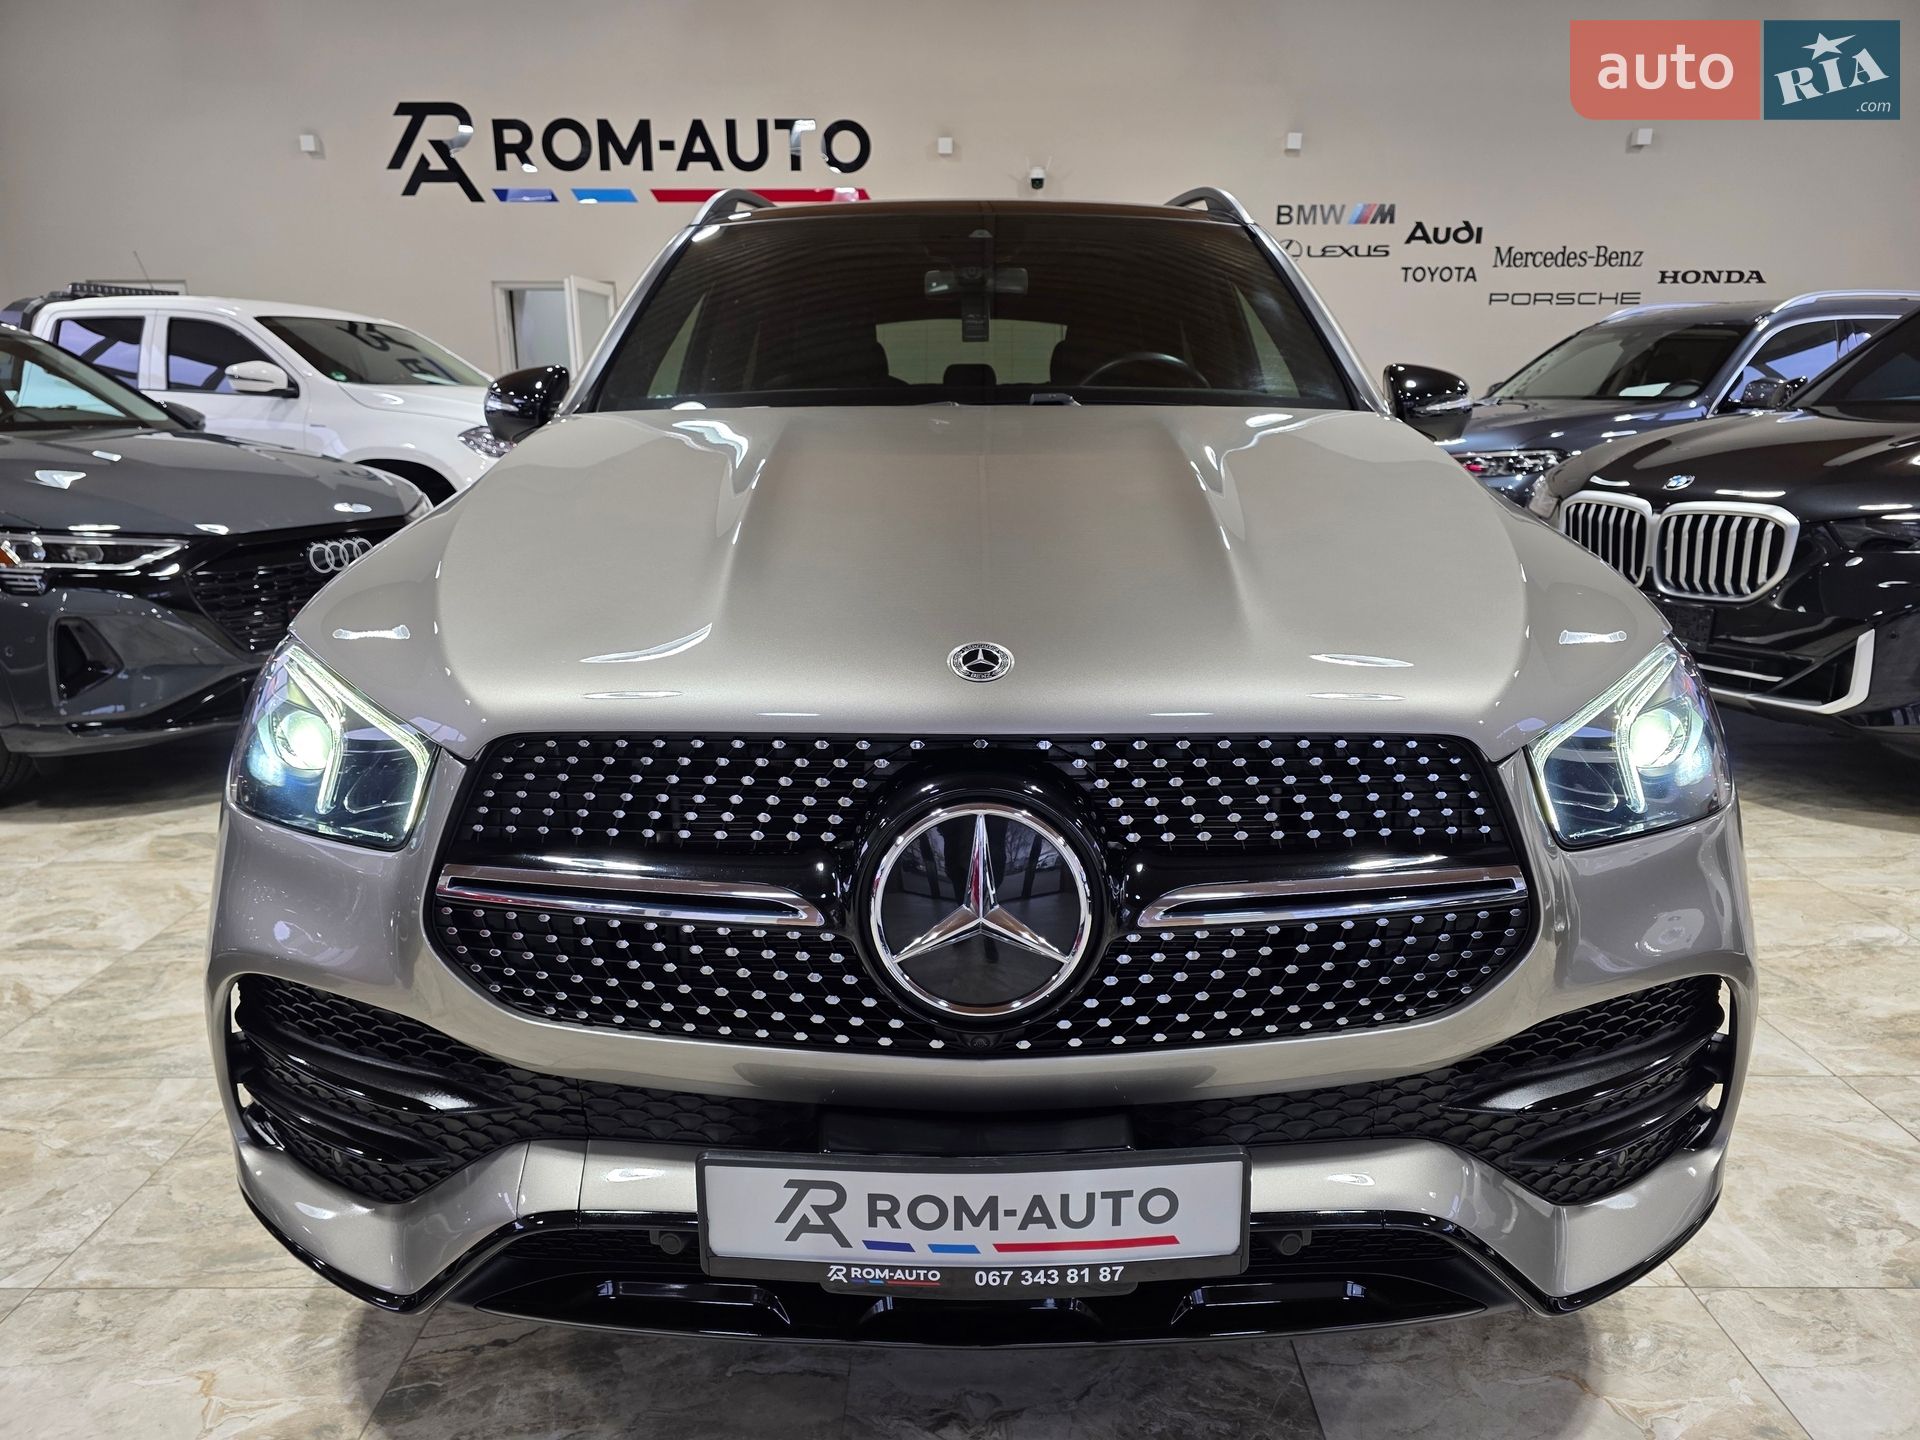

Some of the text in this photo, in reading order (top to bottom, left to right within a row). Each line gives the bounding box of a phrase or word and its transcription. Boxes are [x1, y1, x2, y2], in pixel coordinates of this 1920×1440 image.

[491, 118, 870, 173] ROM-AUTO
[1276, 204, 1346, 225] BMW
[1405, 222, 1482, 245] Audi
[1307, 244, 1390, 258] LEXUS
[1493, 245, 1644, 269] Mercedes-Benz
[1401, 266, 1477, 283] TOYOTA
[1657, 270, 1766, 285] HONDA
[1489, 292, 1642, 306] PORSCHE
[867, 1187, 1179, 1232] ROM-AUTO
[850, 1267, 941, 1281] ROM-AUTO
[974, 1265, 1125, 1287] 067 343 81 87
